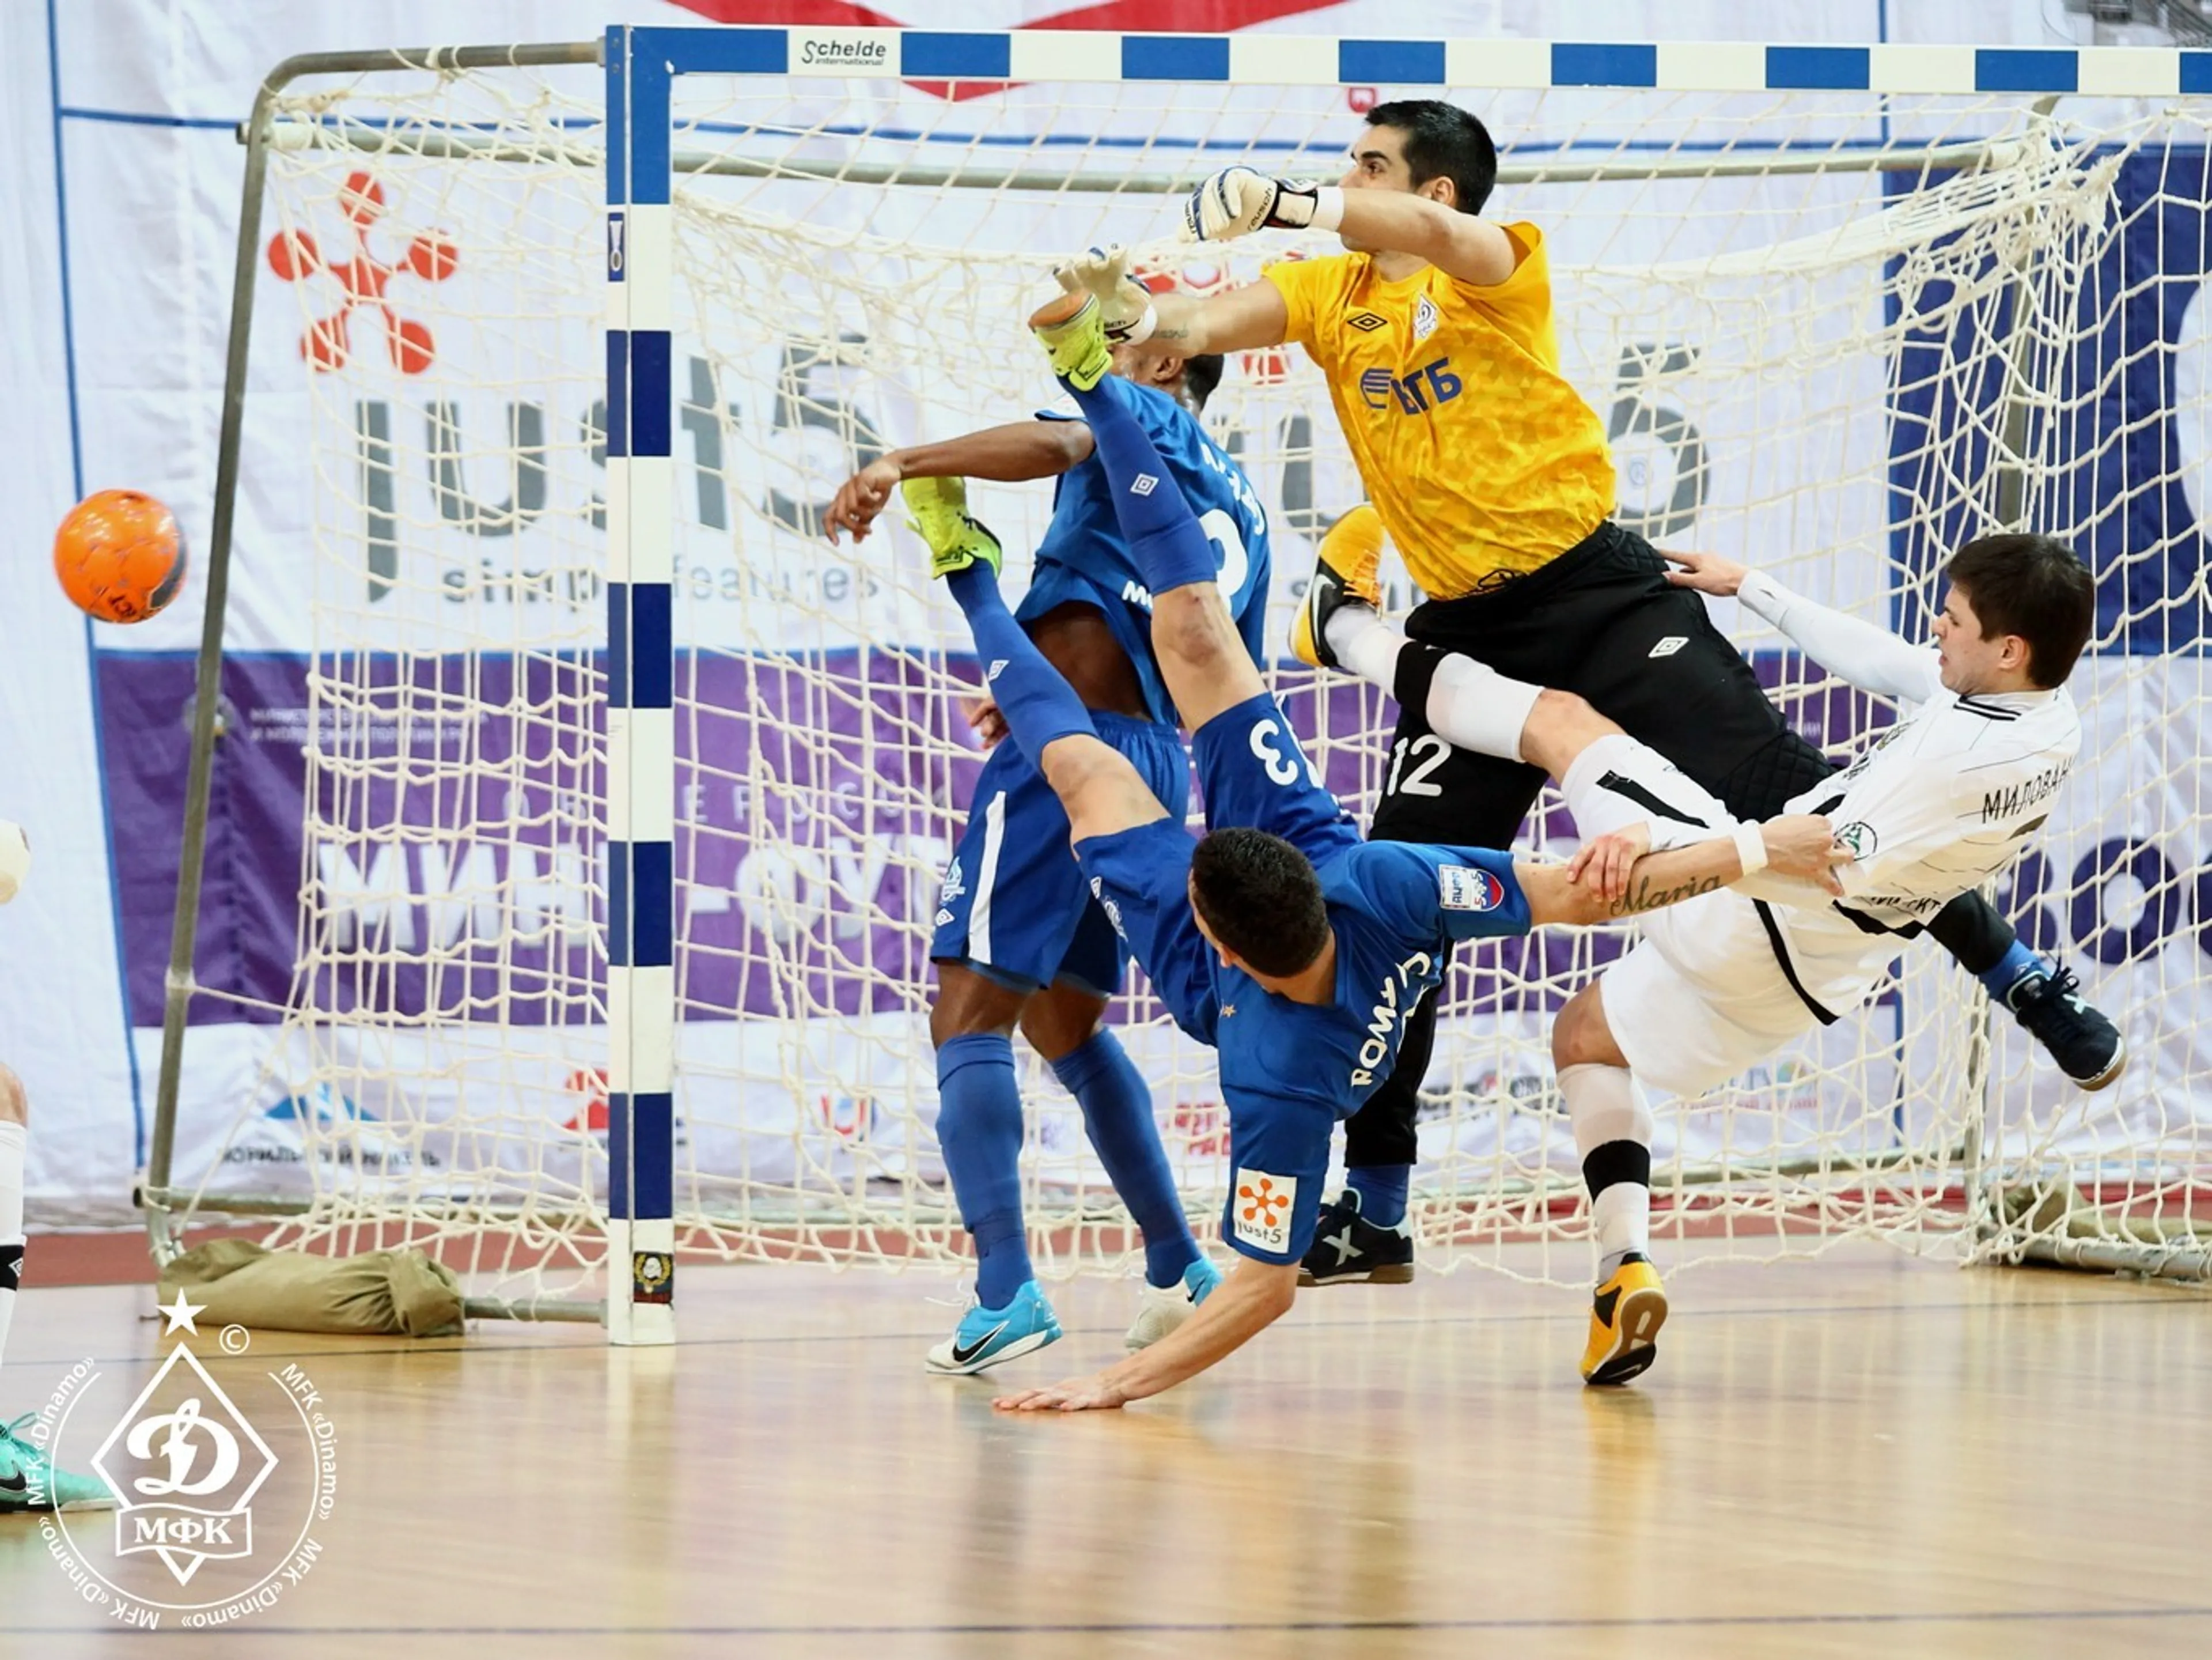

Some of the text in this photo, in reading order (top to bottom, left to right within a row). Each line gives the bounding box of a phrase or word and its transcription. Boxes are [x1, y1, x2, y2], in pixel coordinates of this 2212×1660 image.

[801, 40, 887, 64] Schelde
[1387, 733, 1452, 797] 12
[1609, 875, 1724, 916] Maria
[1238, 1220, 1282, 1244] just5
